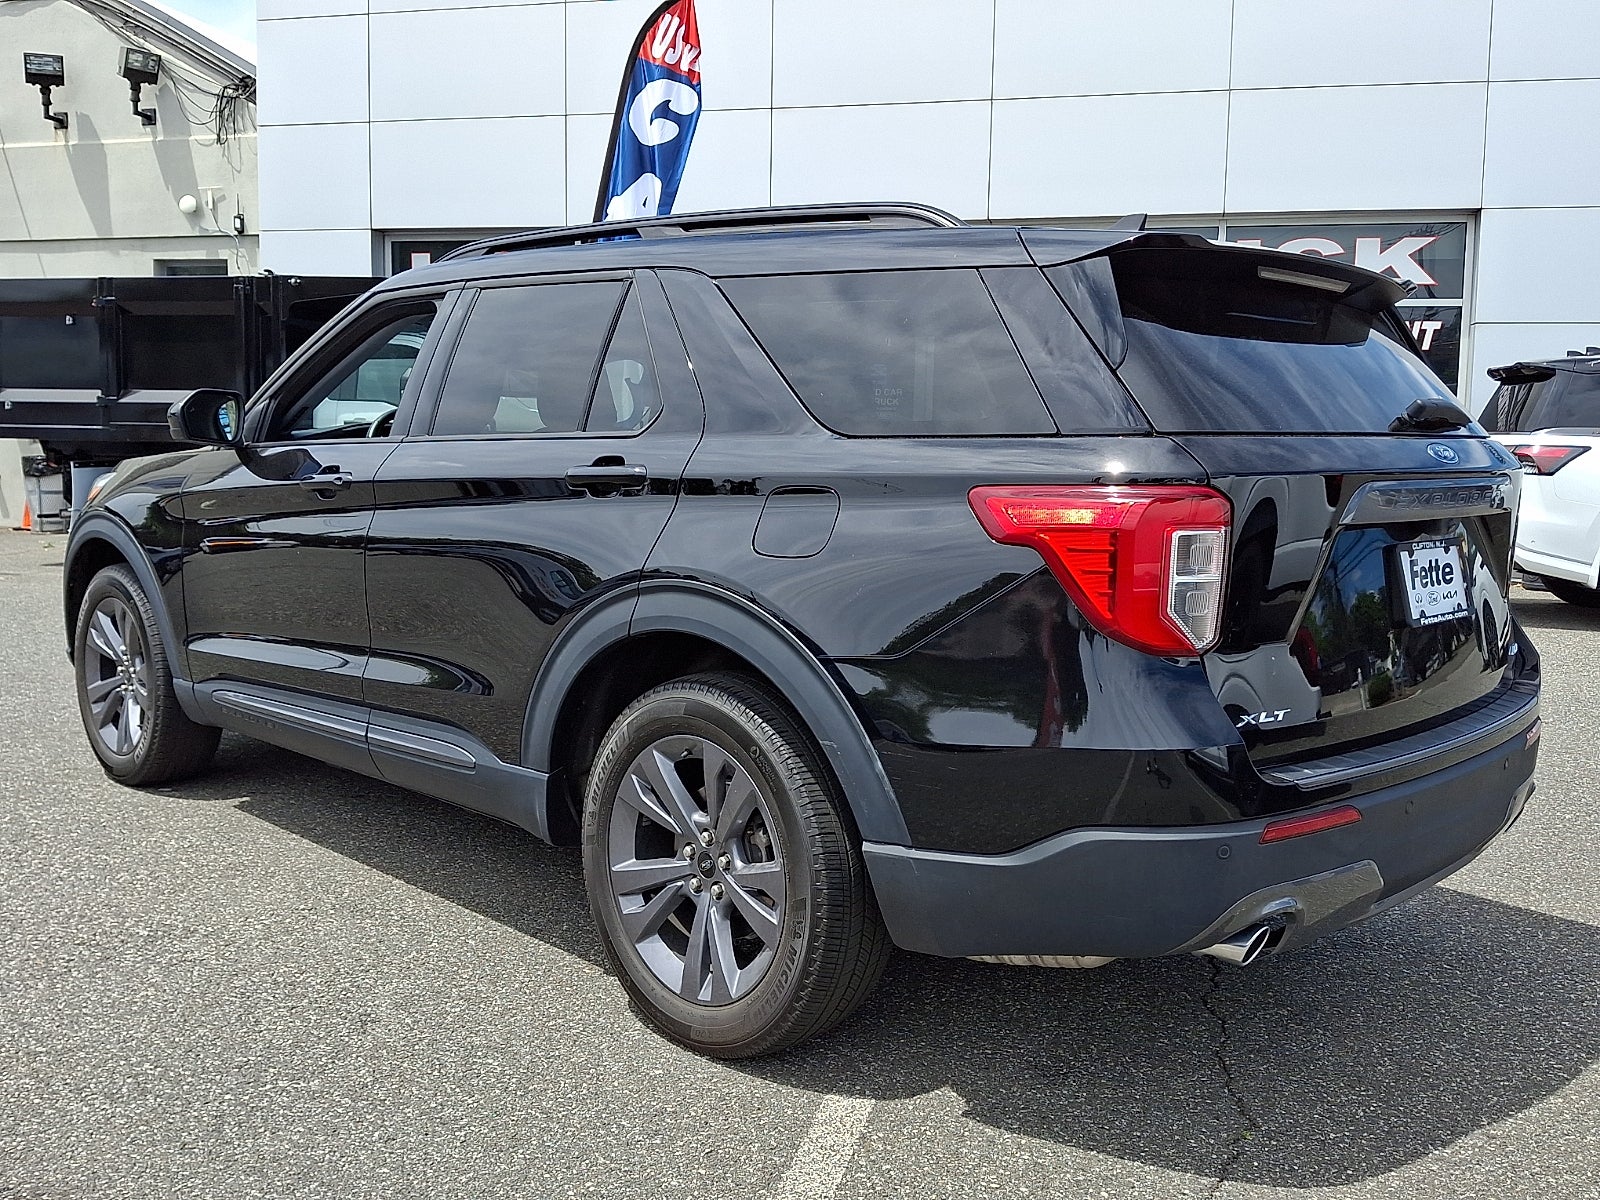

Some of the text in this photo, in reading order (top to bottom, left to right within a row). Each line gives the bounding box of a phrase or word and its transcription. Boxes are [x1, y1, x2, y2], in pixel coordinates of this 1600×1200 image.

[1409, 558, 1454, 591] Fette
[1420, 611, 1469, 626] FetteAuto.com
[1235, 708, 1292, 728] XLT
[591, 724, 629, 807] MICHELIN
